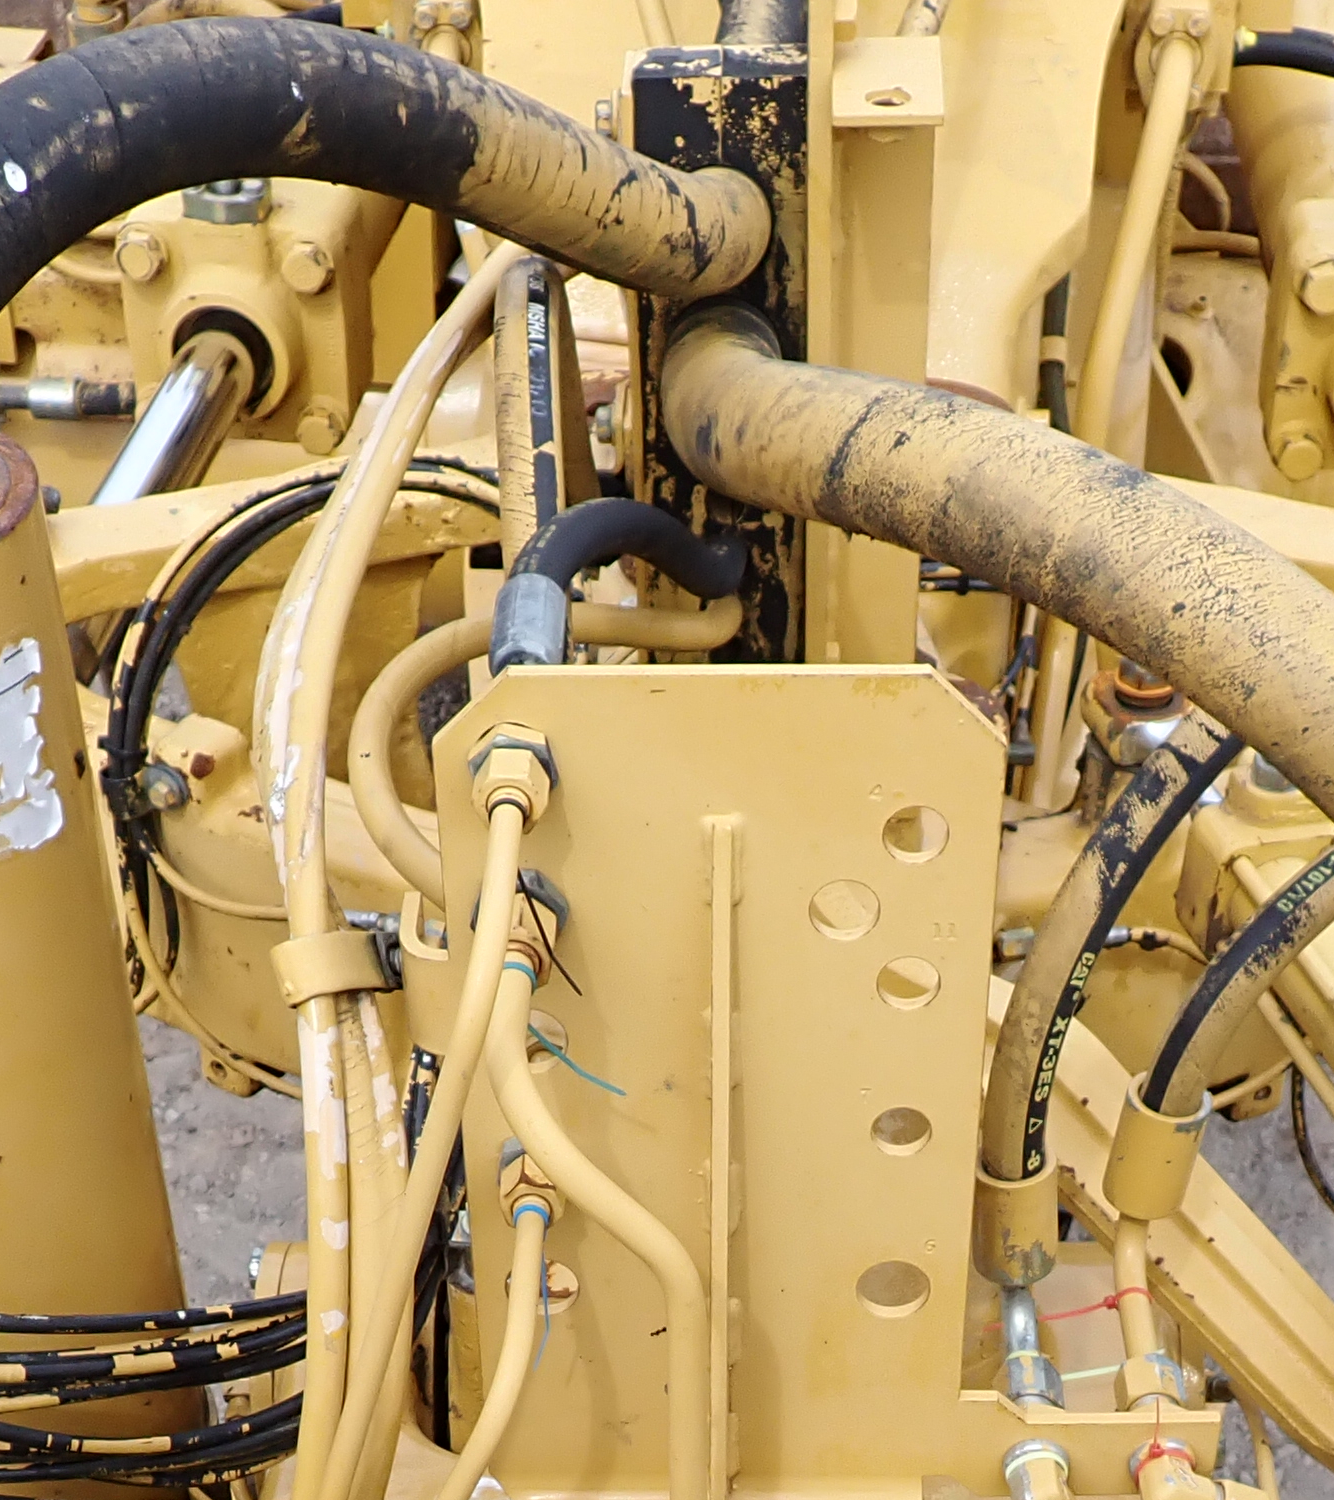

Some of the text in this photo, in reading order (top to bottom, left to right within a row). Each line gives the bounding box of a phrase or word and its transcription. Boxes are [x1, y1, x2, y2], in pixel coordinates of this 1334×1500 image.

[528, 301, 546, 341] MSHA
[1069, 951, 1096, 989] CAT
[1034, 1015, 1070, 1103] XT-3ES
